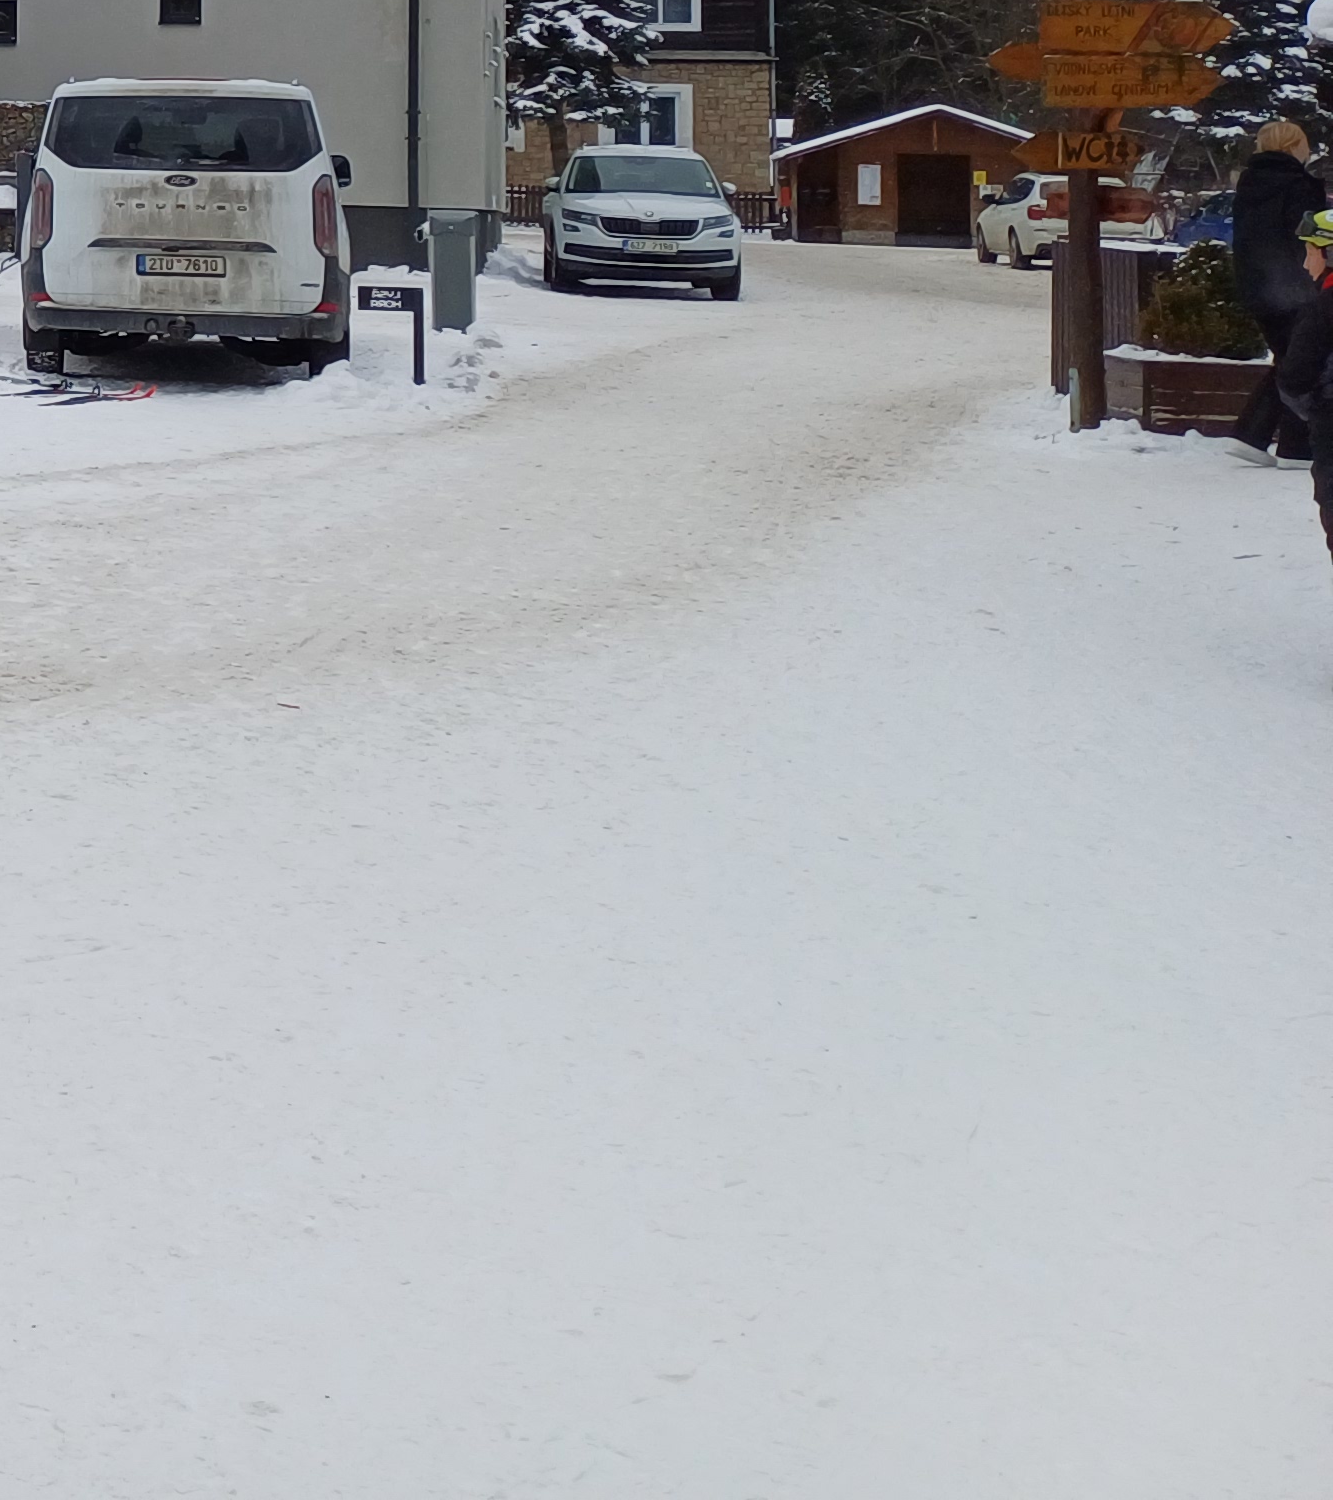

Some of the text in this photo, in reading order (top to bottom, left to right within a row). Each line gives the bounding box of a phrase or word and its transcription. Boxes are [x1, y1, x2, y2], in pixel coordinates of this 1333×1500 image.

[1075, 25, 1112, 37] PARK
[1062, 135, 1106, 163] WC
[148, 257, 218, 272] 2TU 7610
